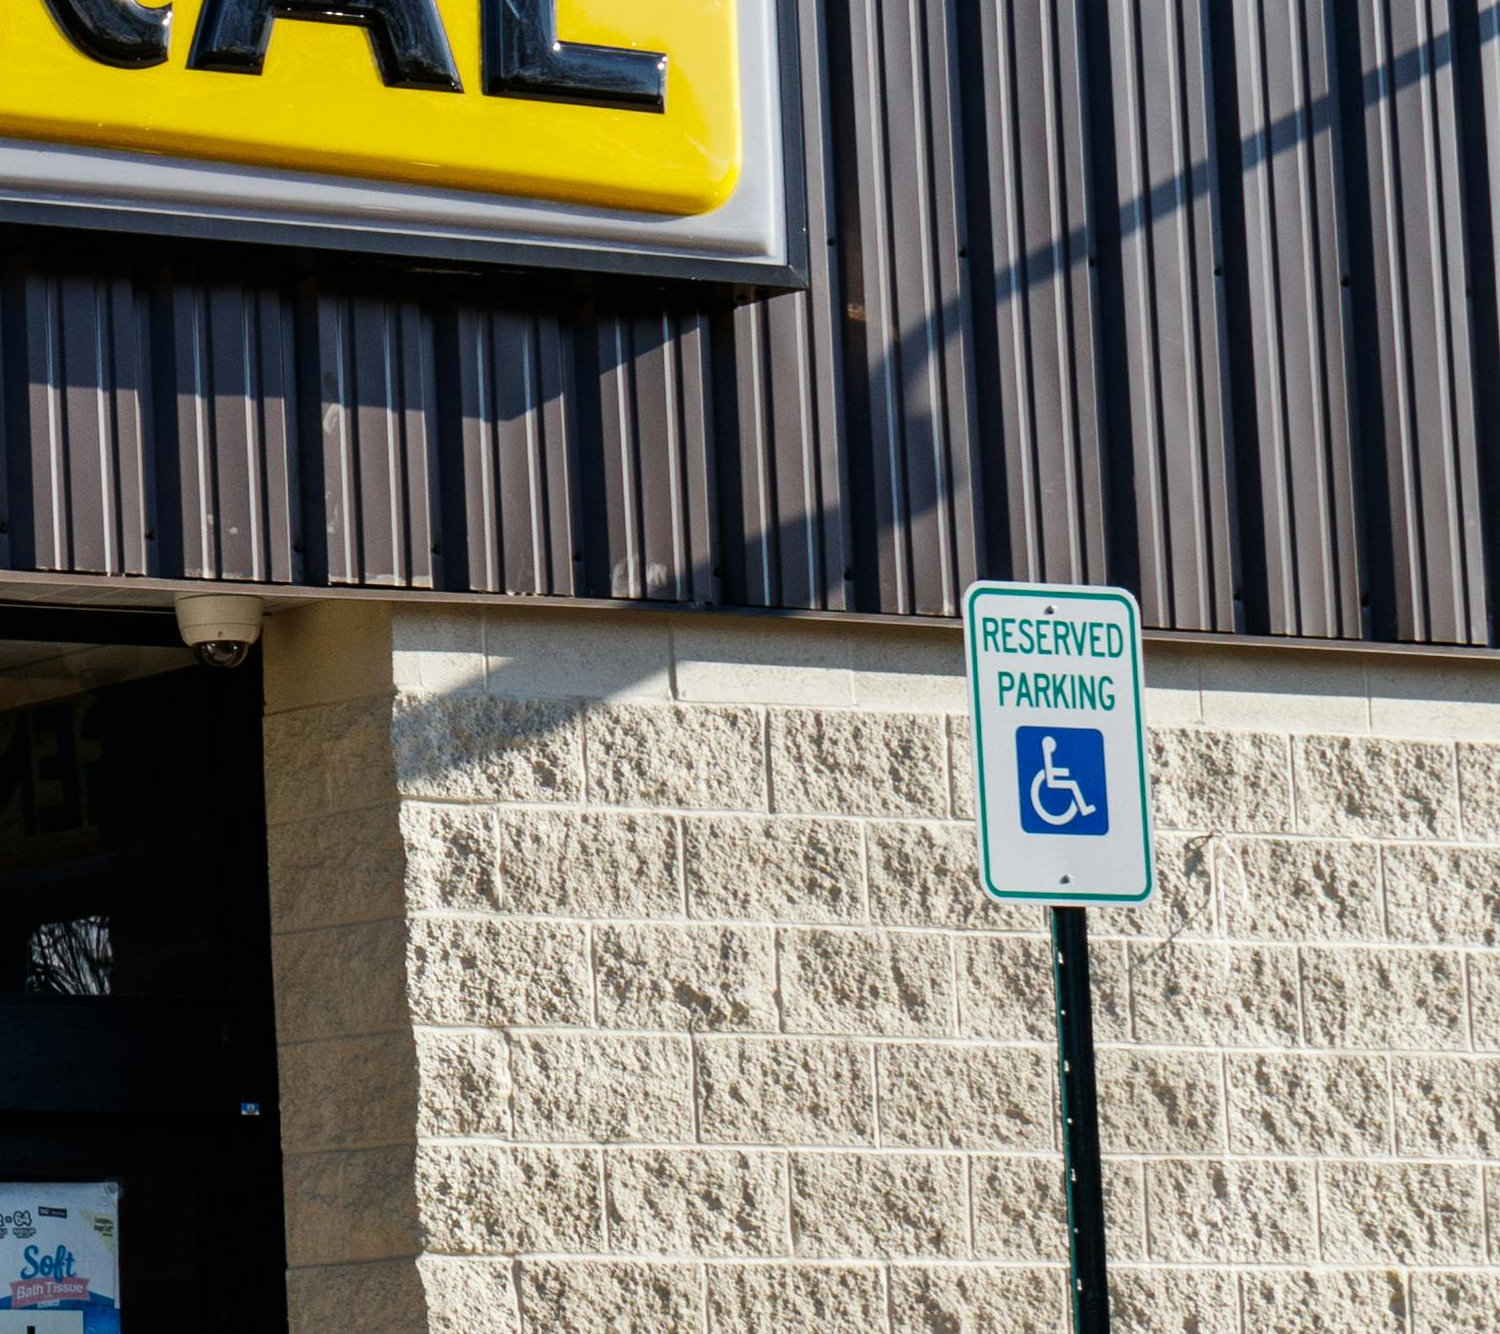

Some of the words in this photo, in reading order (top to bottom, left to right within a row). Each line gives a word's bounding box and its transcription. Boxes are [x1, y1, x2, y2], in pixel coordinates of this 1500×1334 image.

[982, 617, 1124, 658] RESERVED
[998, 671, 1115, 711] PARKING
[13, 1210, 32, 1227] 64
[20, 1244, 76, 1283] Soft
[16, 1283, 44, 1300] Bath
[46, 1280, 84, 1296] Tissue
